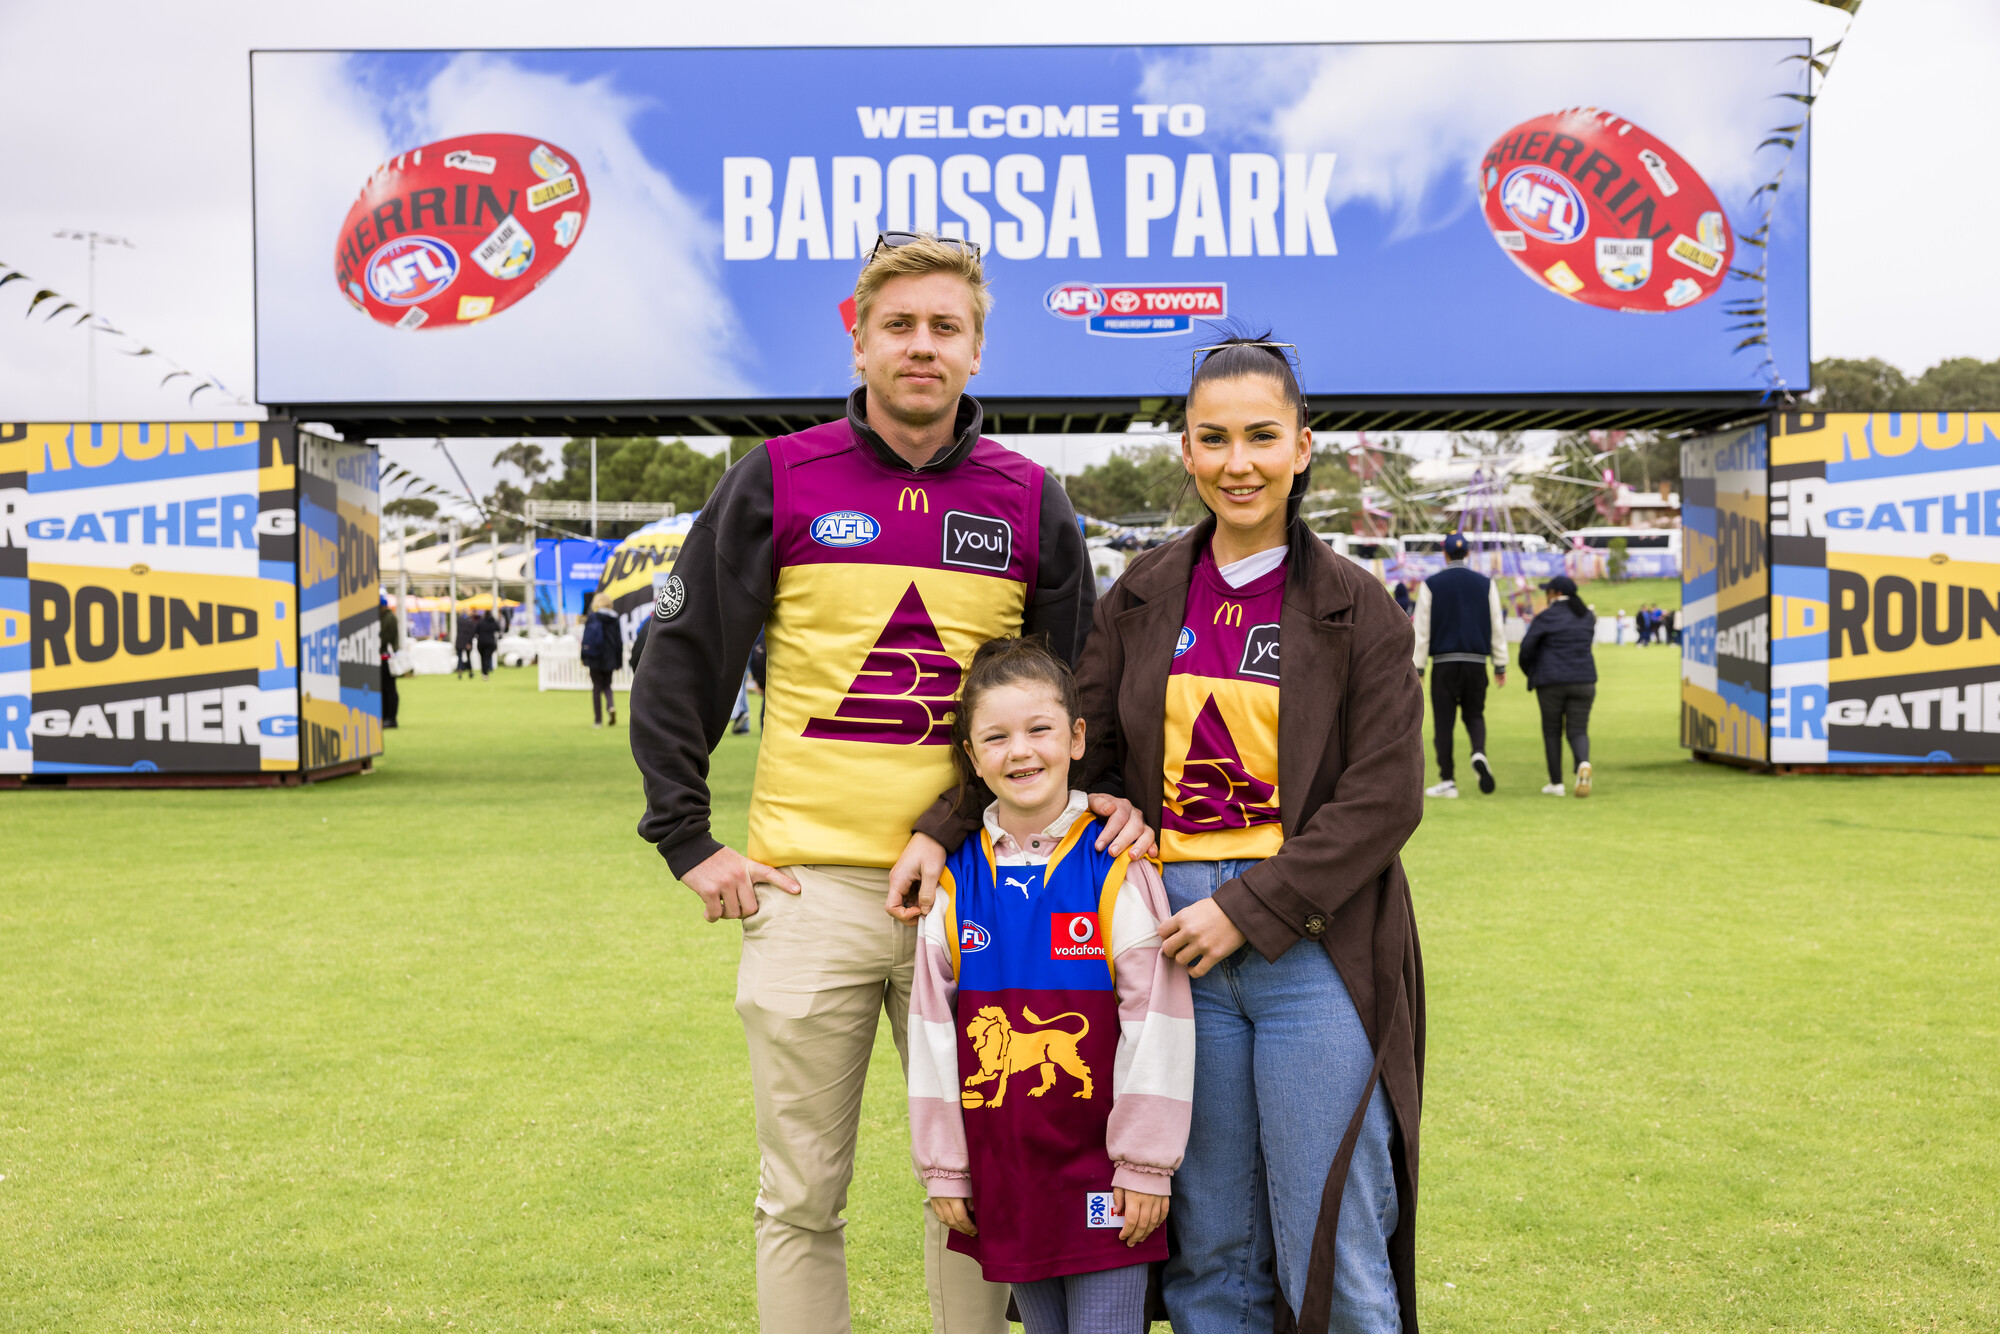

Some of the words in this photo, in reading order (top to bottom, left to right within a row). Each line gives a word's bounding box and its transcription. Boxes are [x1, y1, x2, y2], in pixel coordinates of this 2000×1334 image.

[857, 105, 1119, 138] WELCOME
[1133, 104, 1205, 137] TO
[723, 154, 1102, 260] BAROSSA
[1126, 153, 1338, 258] PARK
[1504, 177, 1575, 240] AFL
[375, 247, 453, 301] AFL
[1051, 291, 1102, 311] AFL
[1143, 293, 1220, 310] TOYOTA
[28, 494, 259, 550] GATHER
[816, 519, 874, 538] AFL
[954, 528, 1003, 554] youi
[30, 579, 258, 670] ROUND
[1829, 568, 2000, 659] ROUN
[31, 685, 260, 746] GATHER
[961, 929, 985, 946] FL
